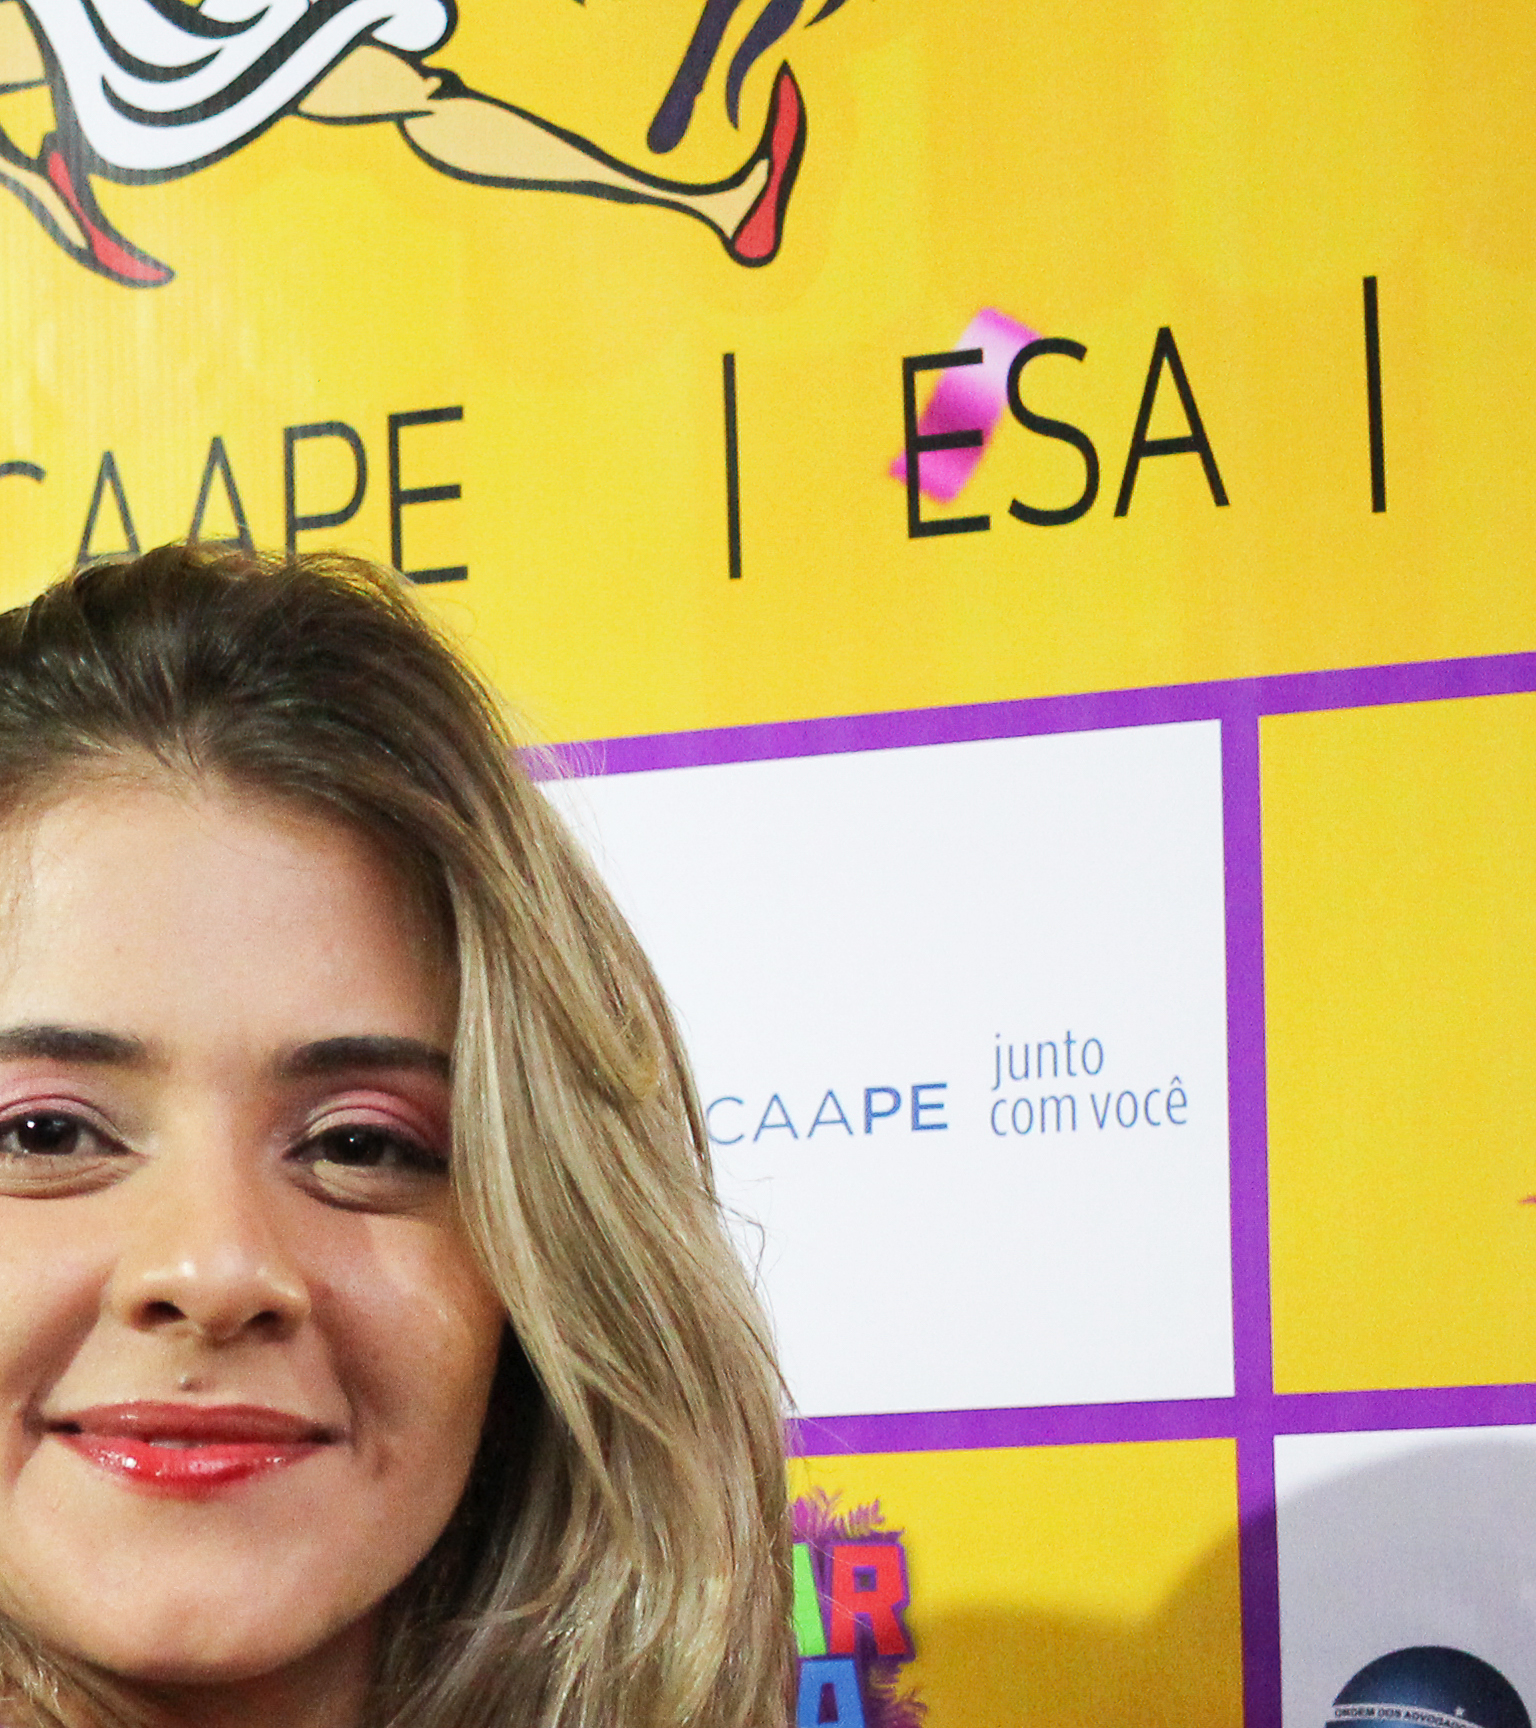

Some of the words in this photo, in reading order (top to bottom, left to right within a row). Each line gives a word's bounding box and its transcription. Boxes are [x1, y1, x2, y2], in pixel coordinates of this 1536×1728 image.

[901, 326, 1230, 539] ESA
[991, 1031, 1105, 1091] junto
[705, 1081, 950, 1145] CAAPE
[990, 1093, 1078, 1137] com
[1090, 1076, 1190, 1131] você
